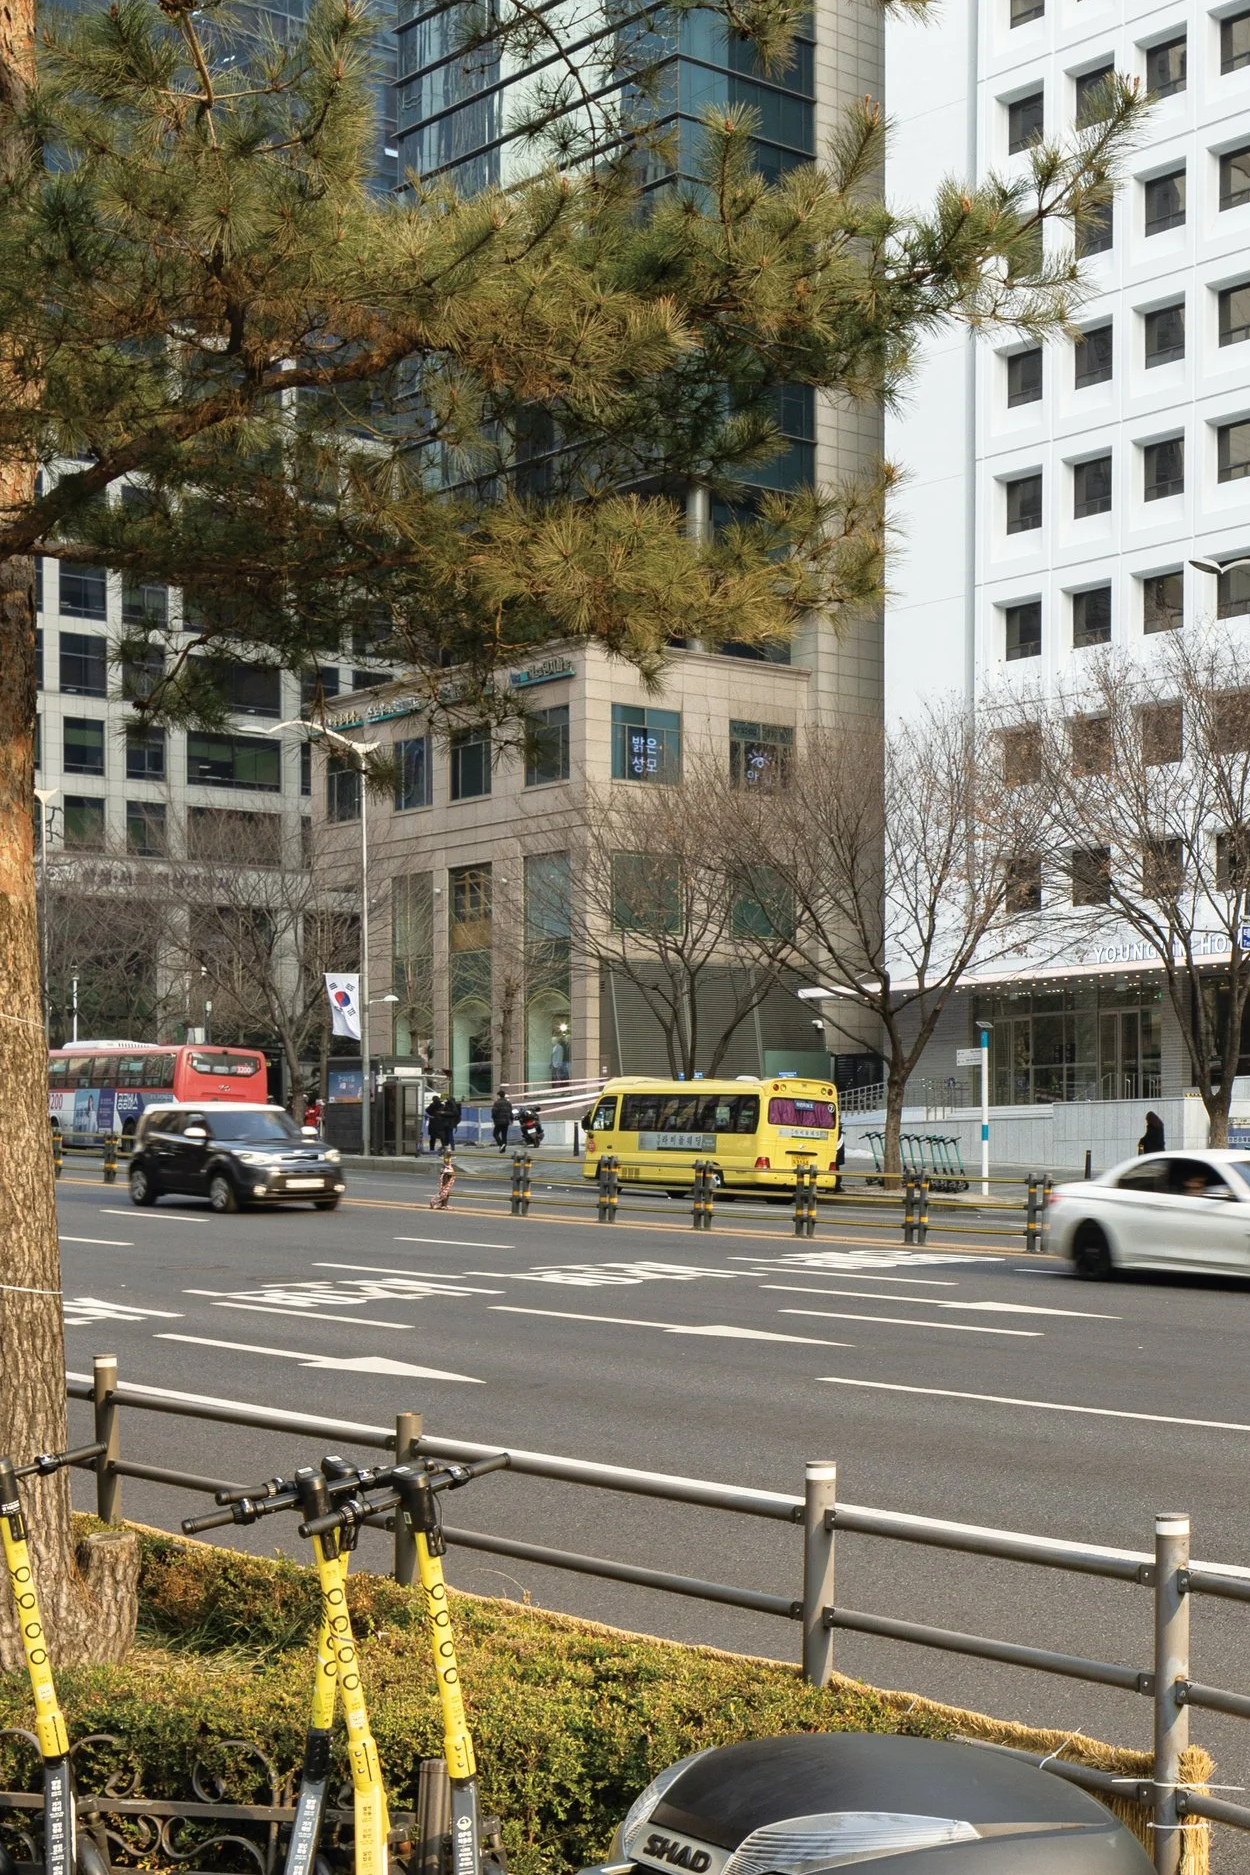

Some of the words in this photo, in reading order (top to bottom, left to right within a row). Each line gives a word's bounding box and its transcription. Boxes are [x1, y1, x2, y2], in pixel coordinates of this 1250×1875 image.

[632, 736, 657, 754] 밝은
[632, 756, 657, 773] 성모
[50, 1094, 63, 1110] 200
[643, 1833, 713, 1873] SHAD
